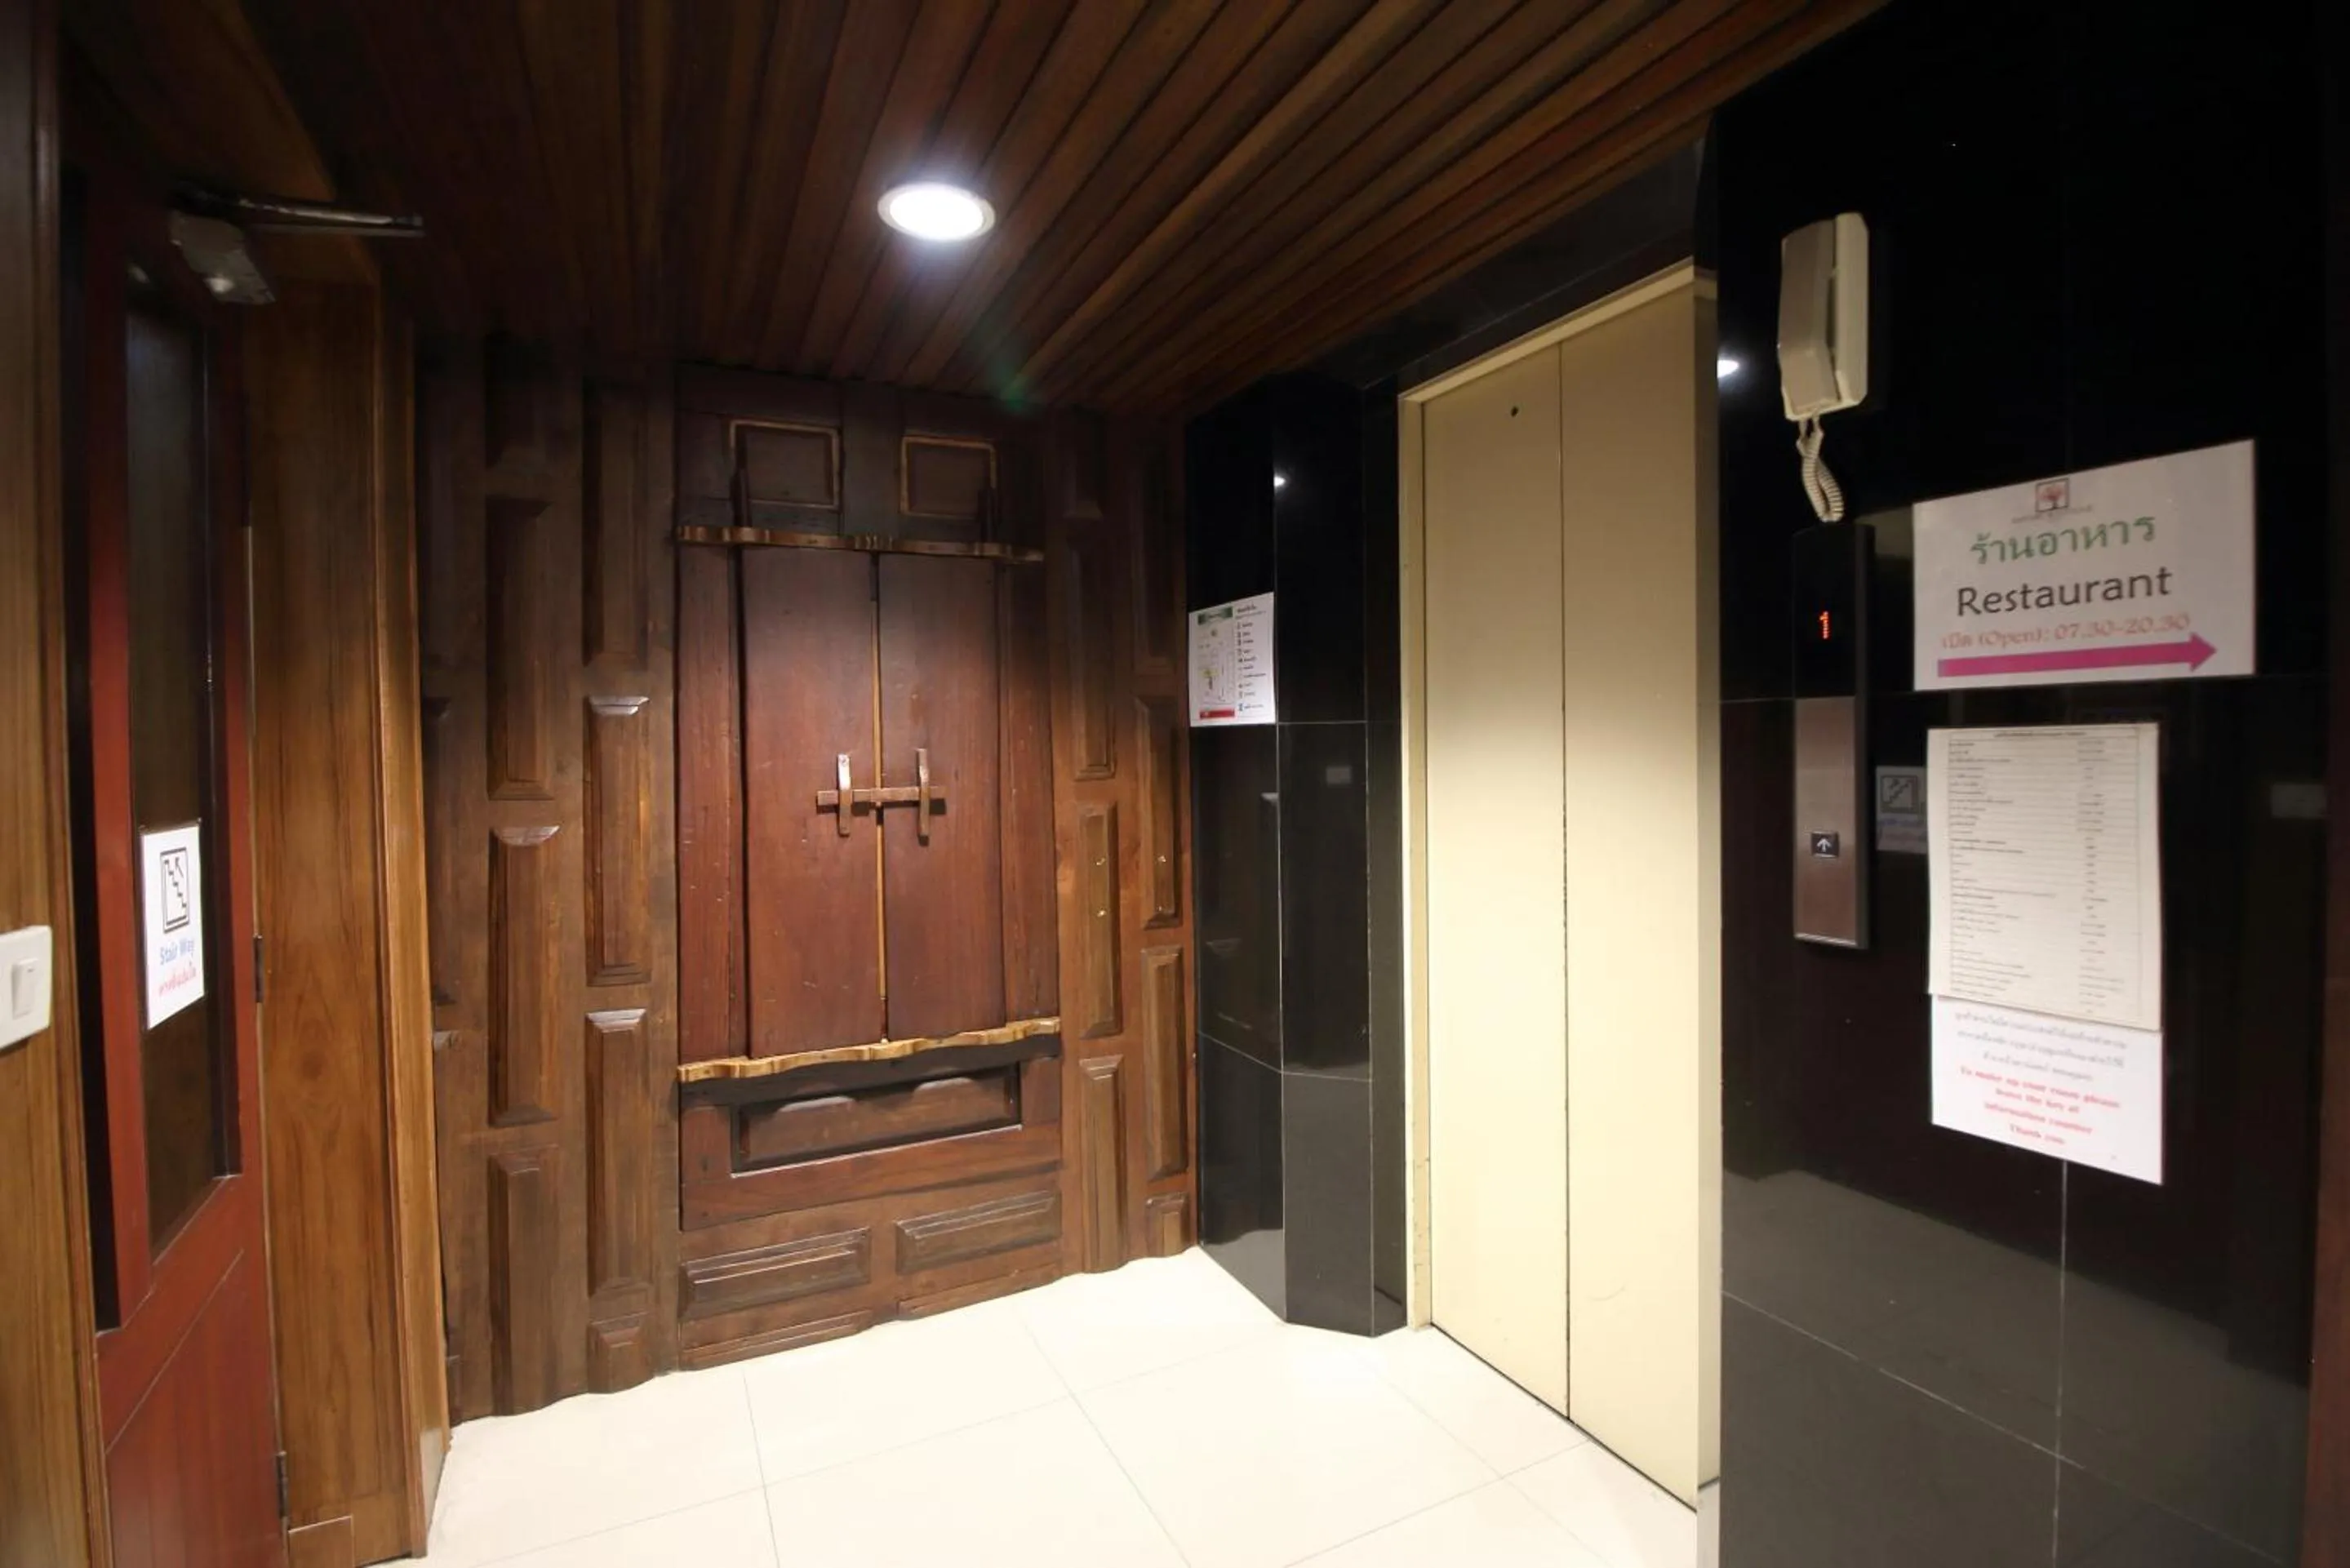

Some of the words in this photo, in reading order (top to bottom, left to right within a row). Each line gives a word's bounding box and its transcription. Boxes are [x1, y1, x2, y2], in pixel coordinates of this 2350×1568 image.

[1970, 515, 2157, 566] ร้านอาหาร
[1957, 566, 2173, 617] Restaurant
[1819, 611, 1829, 640] 1
